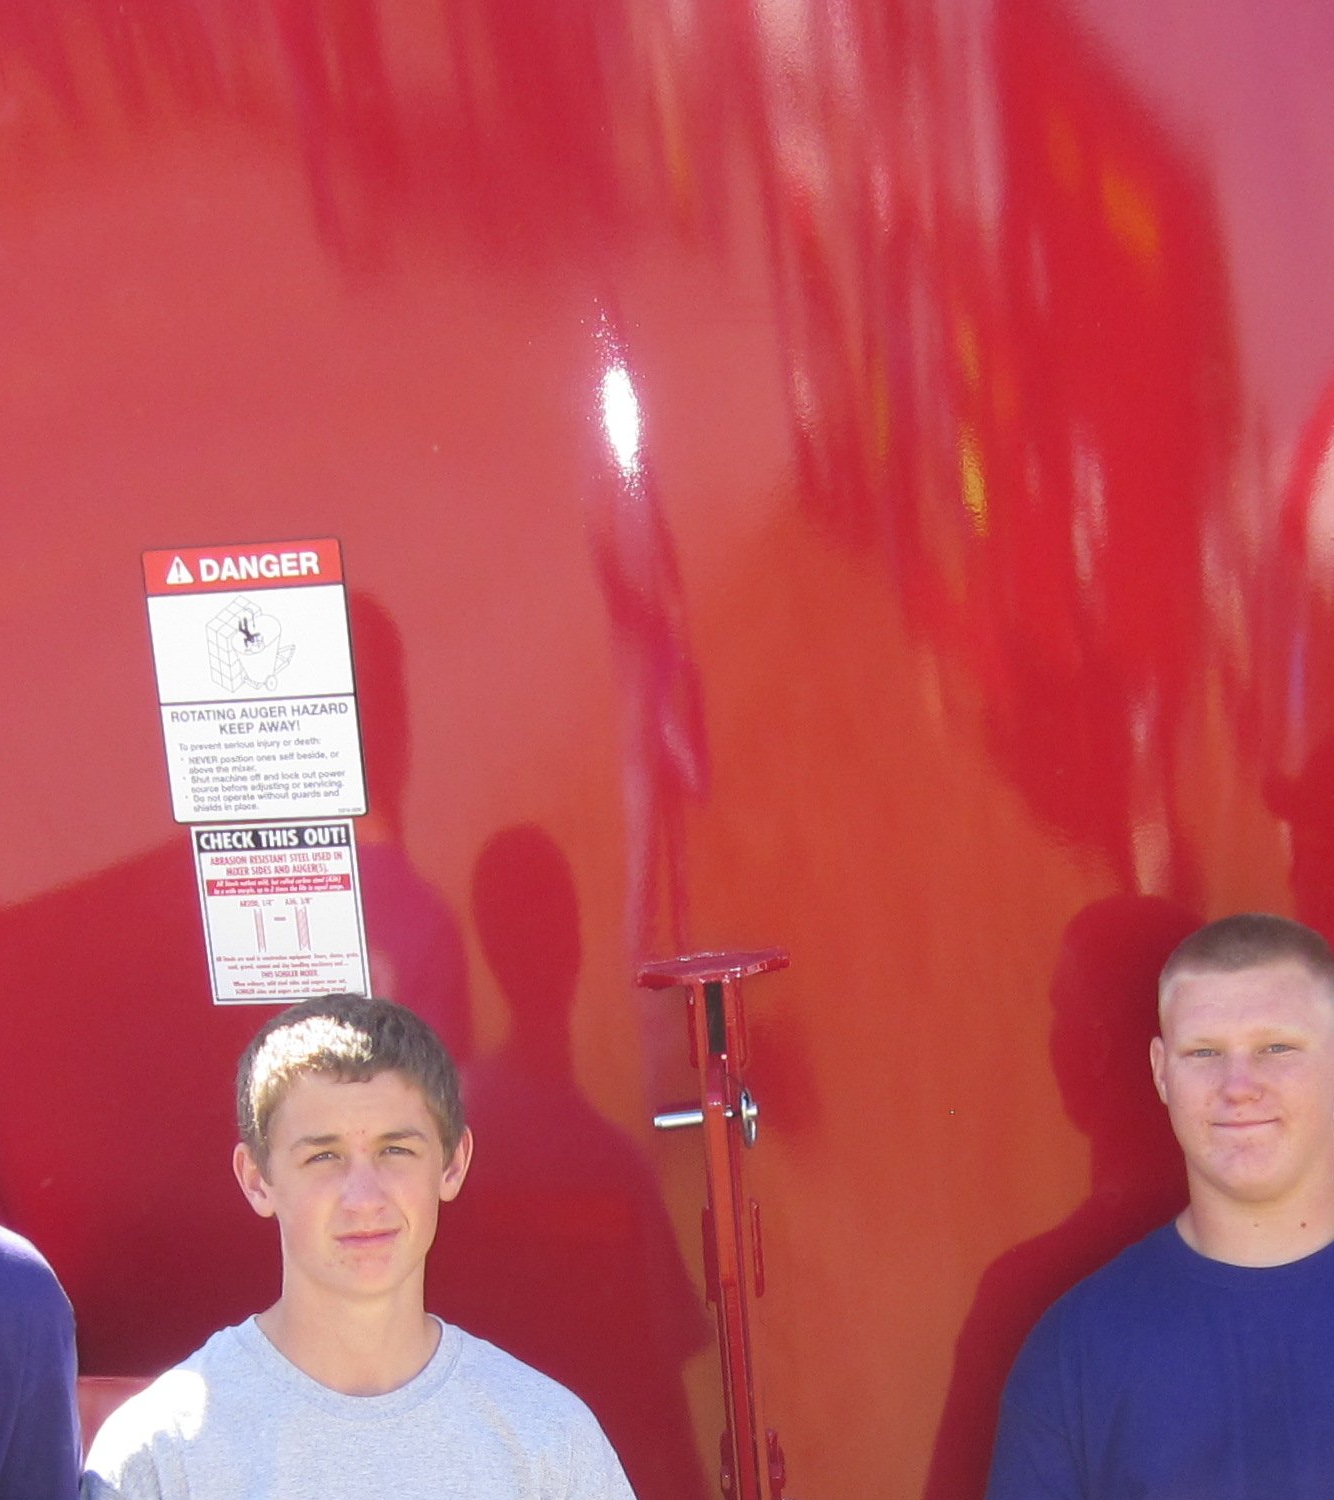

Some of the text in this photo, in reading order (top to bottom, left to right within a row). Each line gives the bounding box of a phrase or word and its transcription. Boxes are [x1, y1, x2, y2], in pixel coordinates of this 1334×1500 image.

[199, 551, 320, 583] DANGER
[170, 702, 348, 723] ROTATING AUGER HAZARD
[219, 719, 300, 735] KEEP AWAY!
[179, 743, 188, 751] To
[190, 742, 221, 752] prevent
[189, 755, 217, 764] NEVER
[220, 754, 253, 764] position
[200, 826, 347, 850] CHECK THIS OUT!
[289, 852, 310, 862] STEEL
[312, 851, 331, 861] USED
